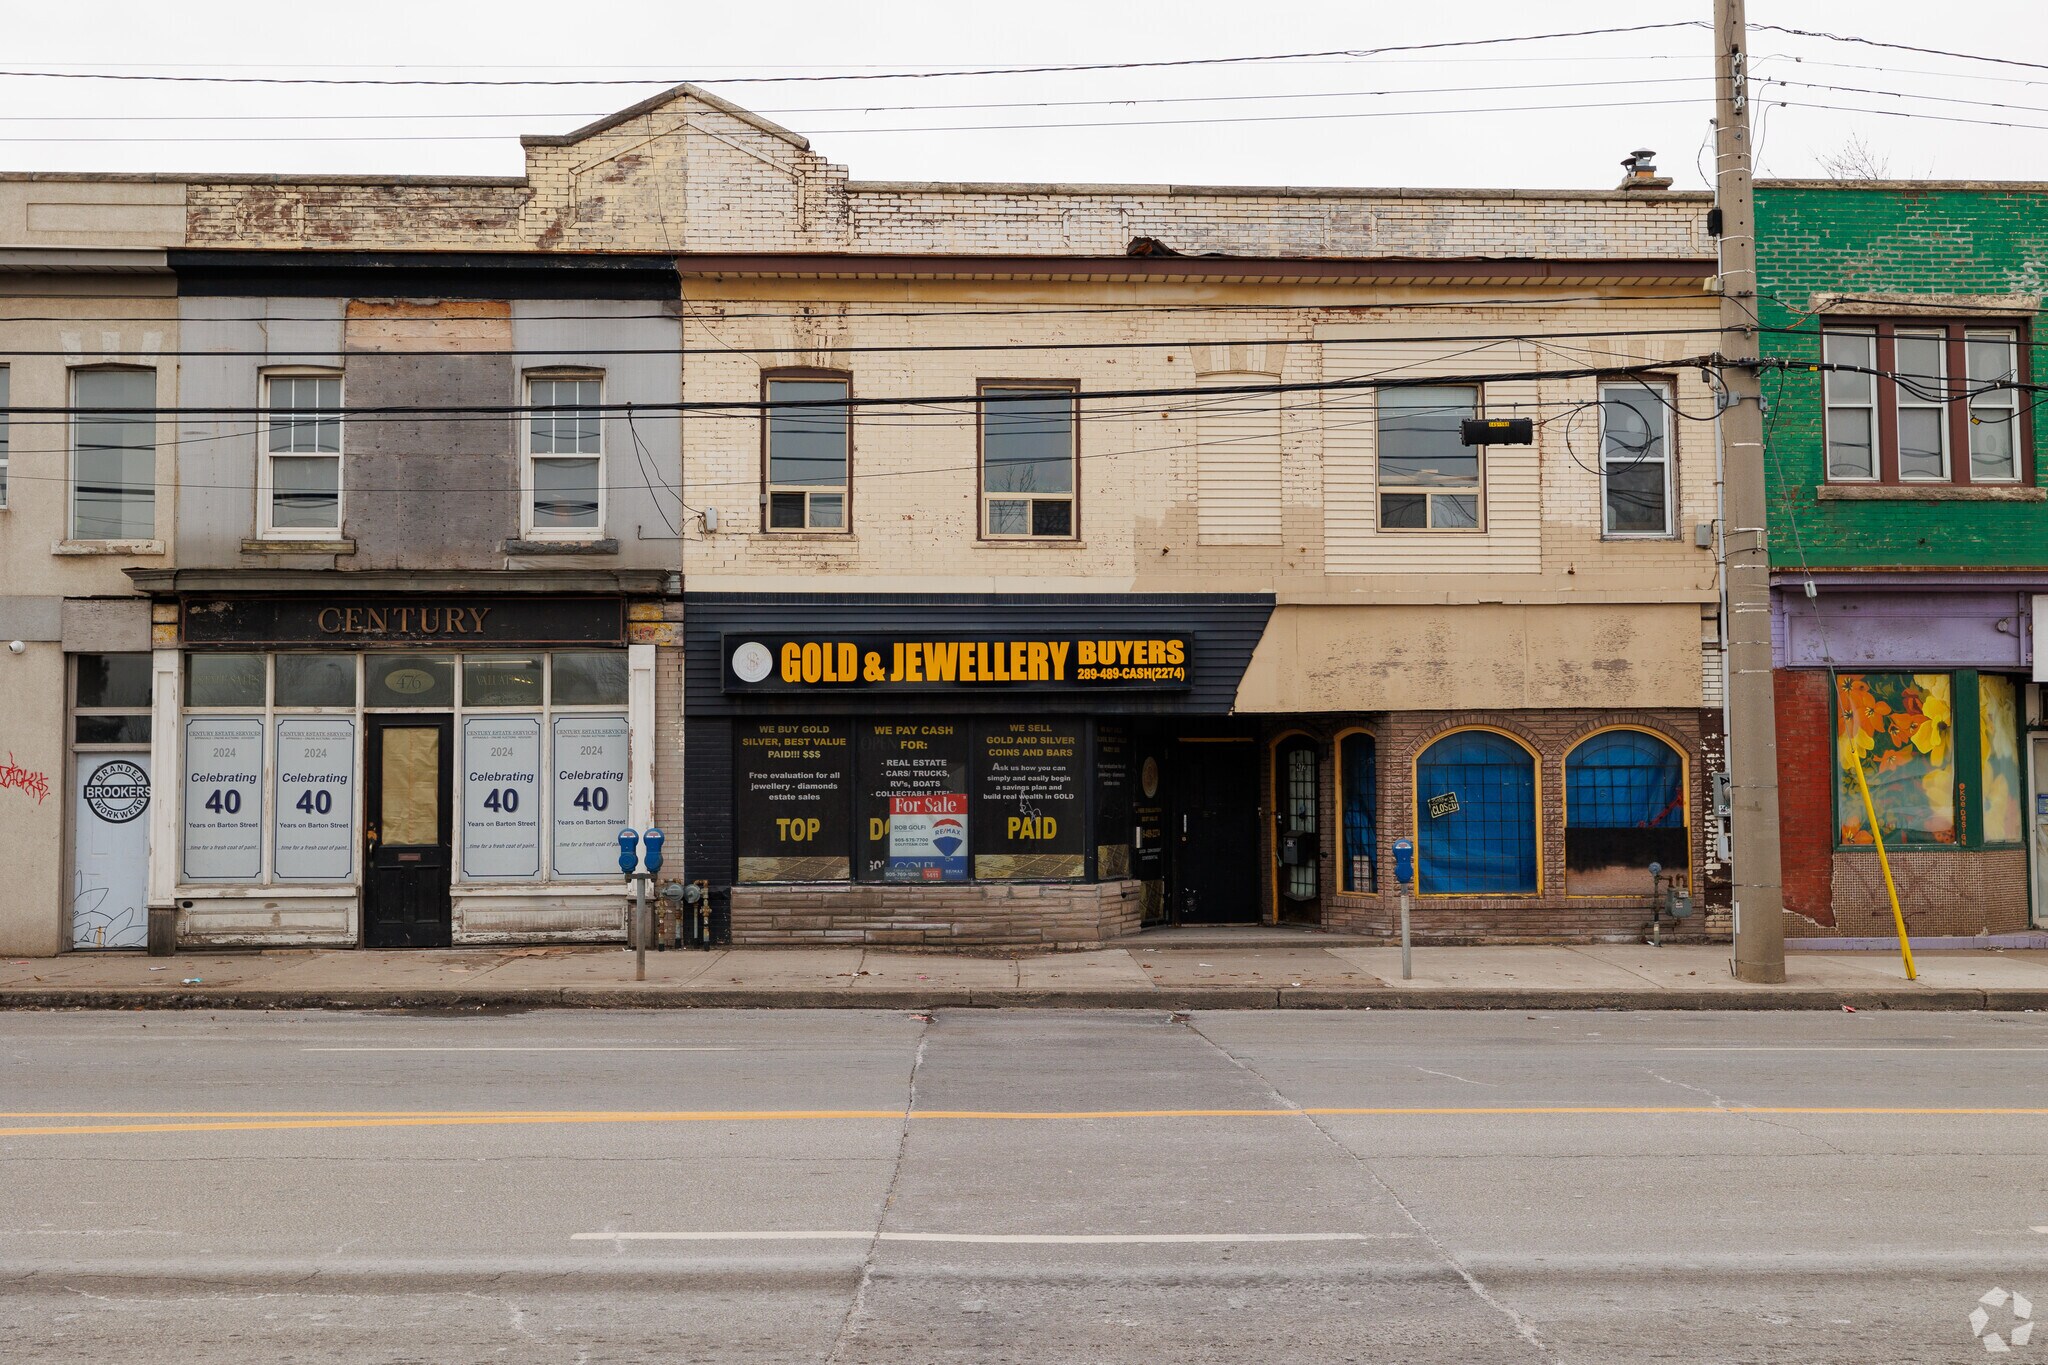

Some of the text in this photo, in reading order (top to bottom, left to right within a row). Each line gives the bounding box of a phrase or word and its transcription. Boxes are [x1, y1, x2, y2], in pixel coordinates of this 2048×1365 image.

[318, 607, 491, 633] CENTURY
[1078, 640, 1185, 665] BUYERS
[782, 642, 1070, 682] GOLD & JEWELLERY
[1078, 667, 1184, 681] 289-489-CASH(2274)
[396, 674, 421, 690] 476
[874, 726, 953, 734] WE PAY CASH
[742, 738, 781, 747] SILVER,
[900, 741, 928, 749] FOR:
[213, 748, 236, 757] 2024
[304, 748, 327, 758] 2024
[491, 747, 513, 756] 2024
[580, 746, 603, 755] 2024
[802, 751, 821, 759] $$$
[95, 764, 144, 782] BRANDED
[191, 773, 256, 784] Celebrating
[282, 773, 347, 785] Celebrating
[470, 772, 534, 783] Celebrating
[559, 770, 623, 782] Celebrating
[86, 786, 151, 798] BROOKERS
[574, 787, 609, 811] 40
[205, 789, 241, 814] 40
[296, 790, 332, 814] 40
[484, 788, 519, 813] 40
[895, 797, 956, 813] For Sale
[1432, 800, 1456, 814] CLOSED
[95, 799, 144, 819] WORKWEAR
[776, 818, 820, 841] TOP
[1008, 816, 1057, 840] PAID
